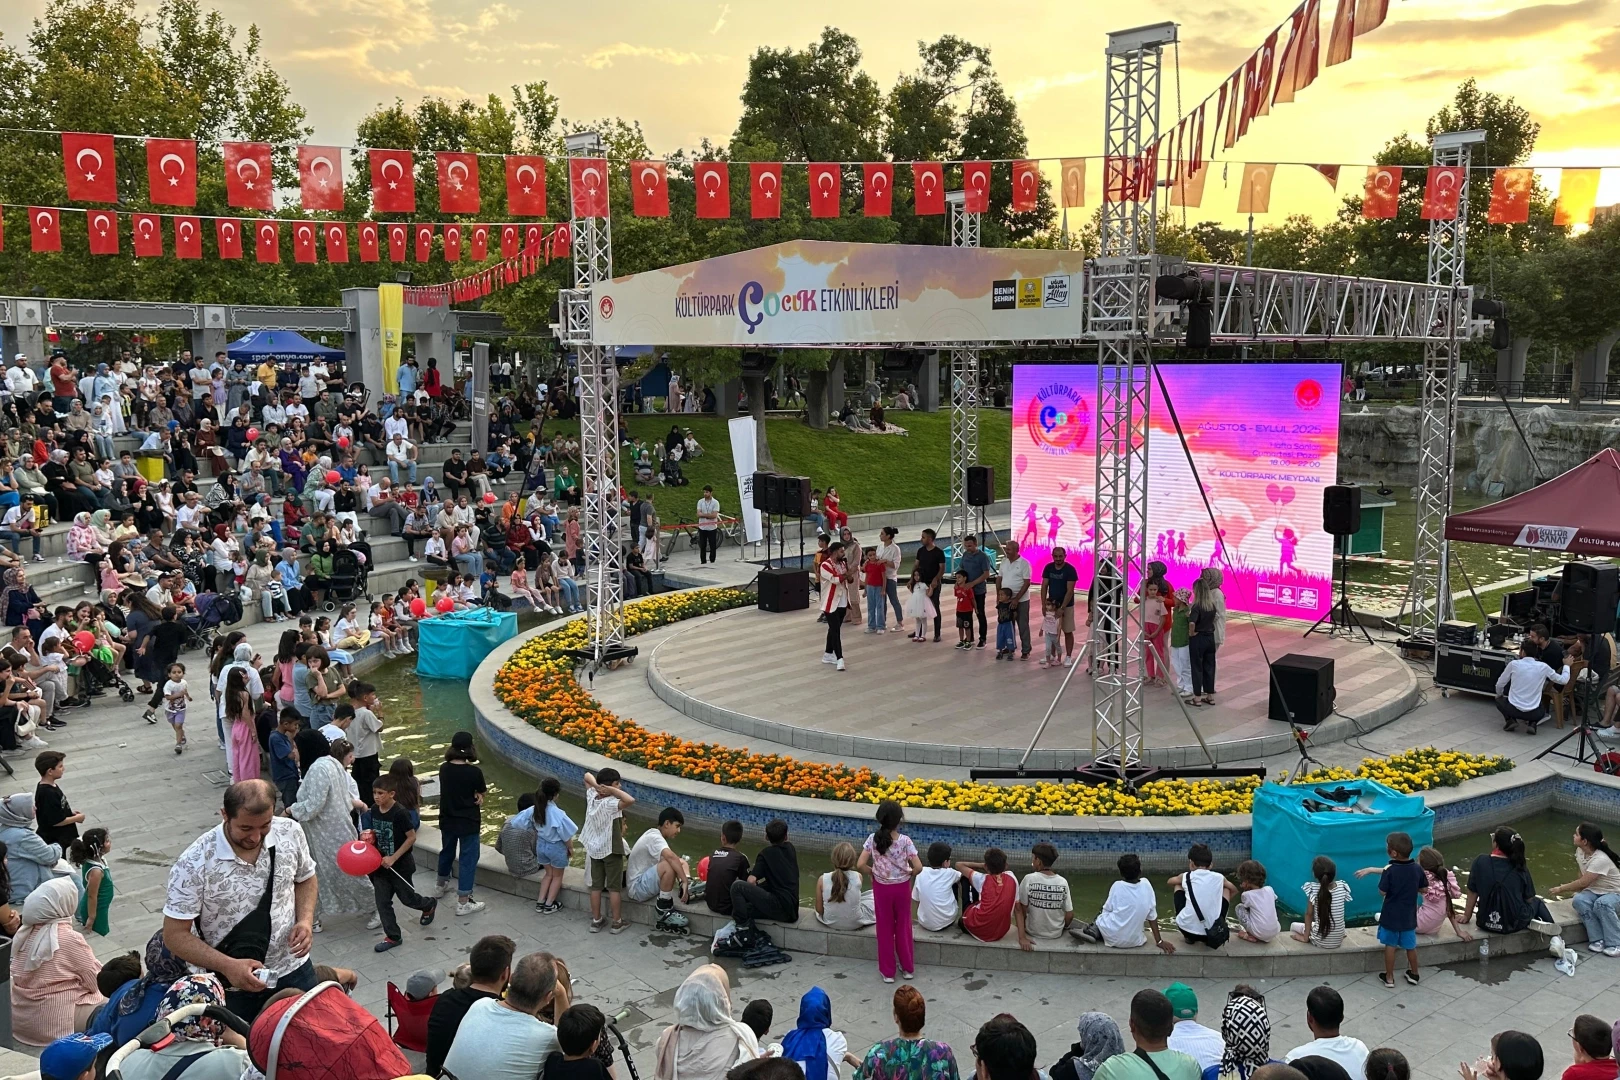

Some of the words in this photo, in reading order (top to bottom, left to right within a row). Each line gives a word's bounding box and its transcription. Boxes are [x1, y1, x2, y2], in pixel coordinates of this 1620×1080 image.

[675, 292, 735, 318] KÜLTÜRPARK
[820, 280, 899, 312] ETKİNLİKLERİ
[1036, 383, 1082, 406] KÜLTÜRPARK
[1198, 422, 1247, 431] AĞUSTOS
[1291, 424, 1321, 434] 2025
[1219, 469, 1277, 480] KÜLTÜRPARK
[1278, 474, 1321, 483] MEYDANI
[1540, 528, 1568, 537] KÜLTÜR
[1540, 535, 1568, 545] SANAT
[1579, 537, 1605, 546] KÜLTÜR
